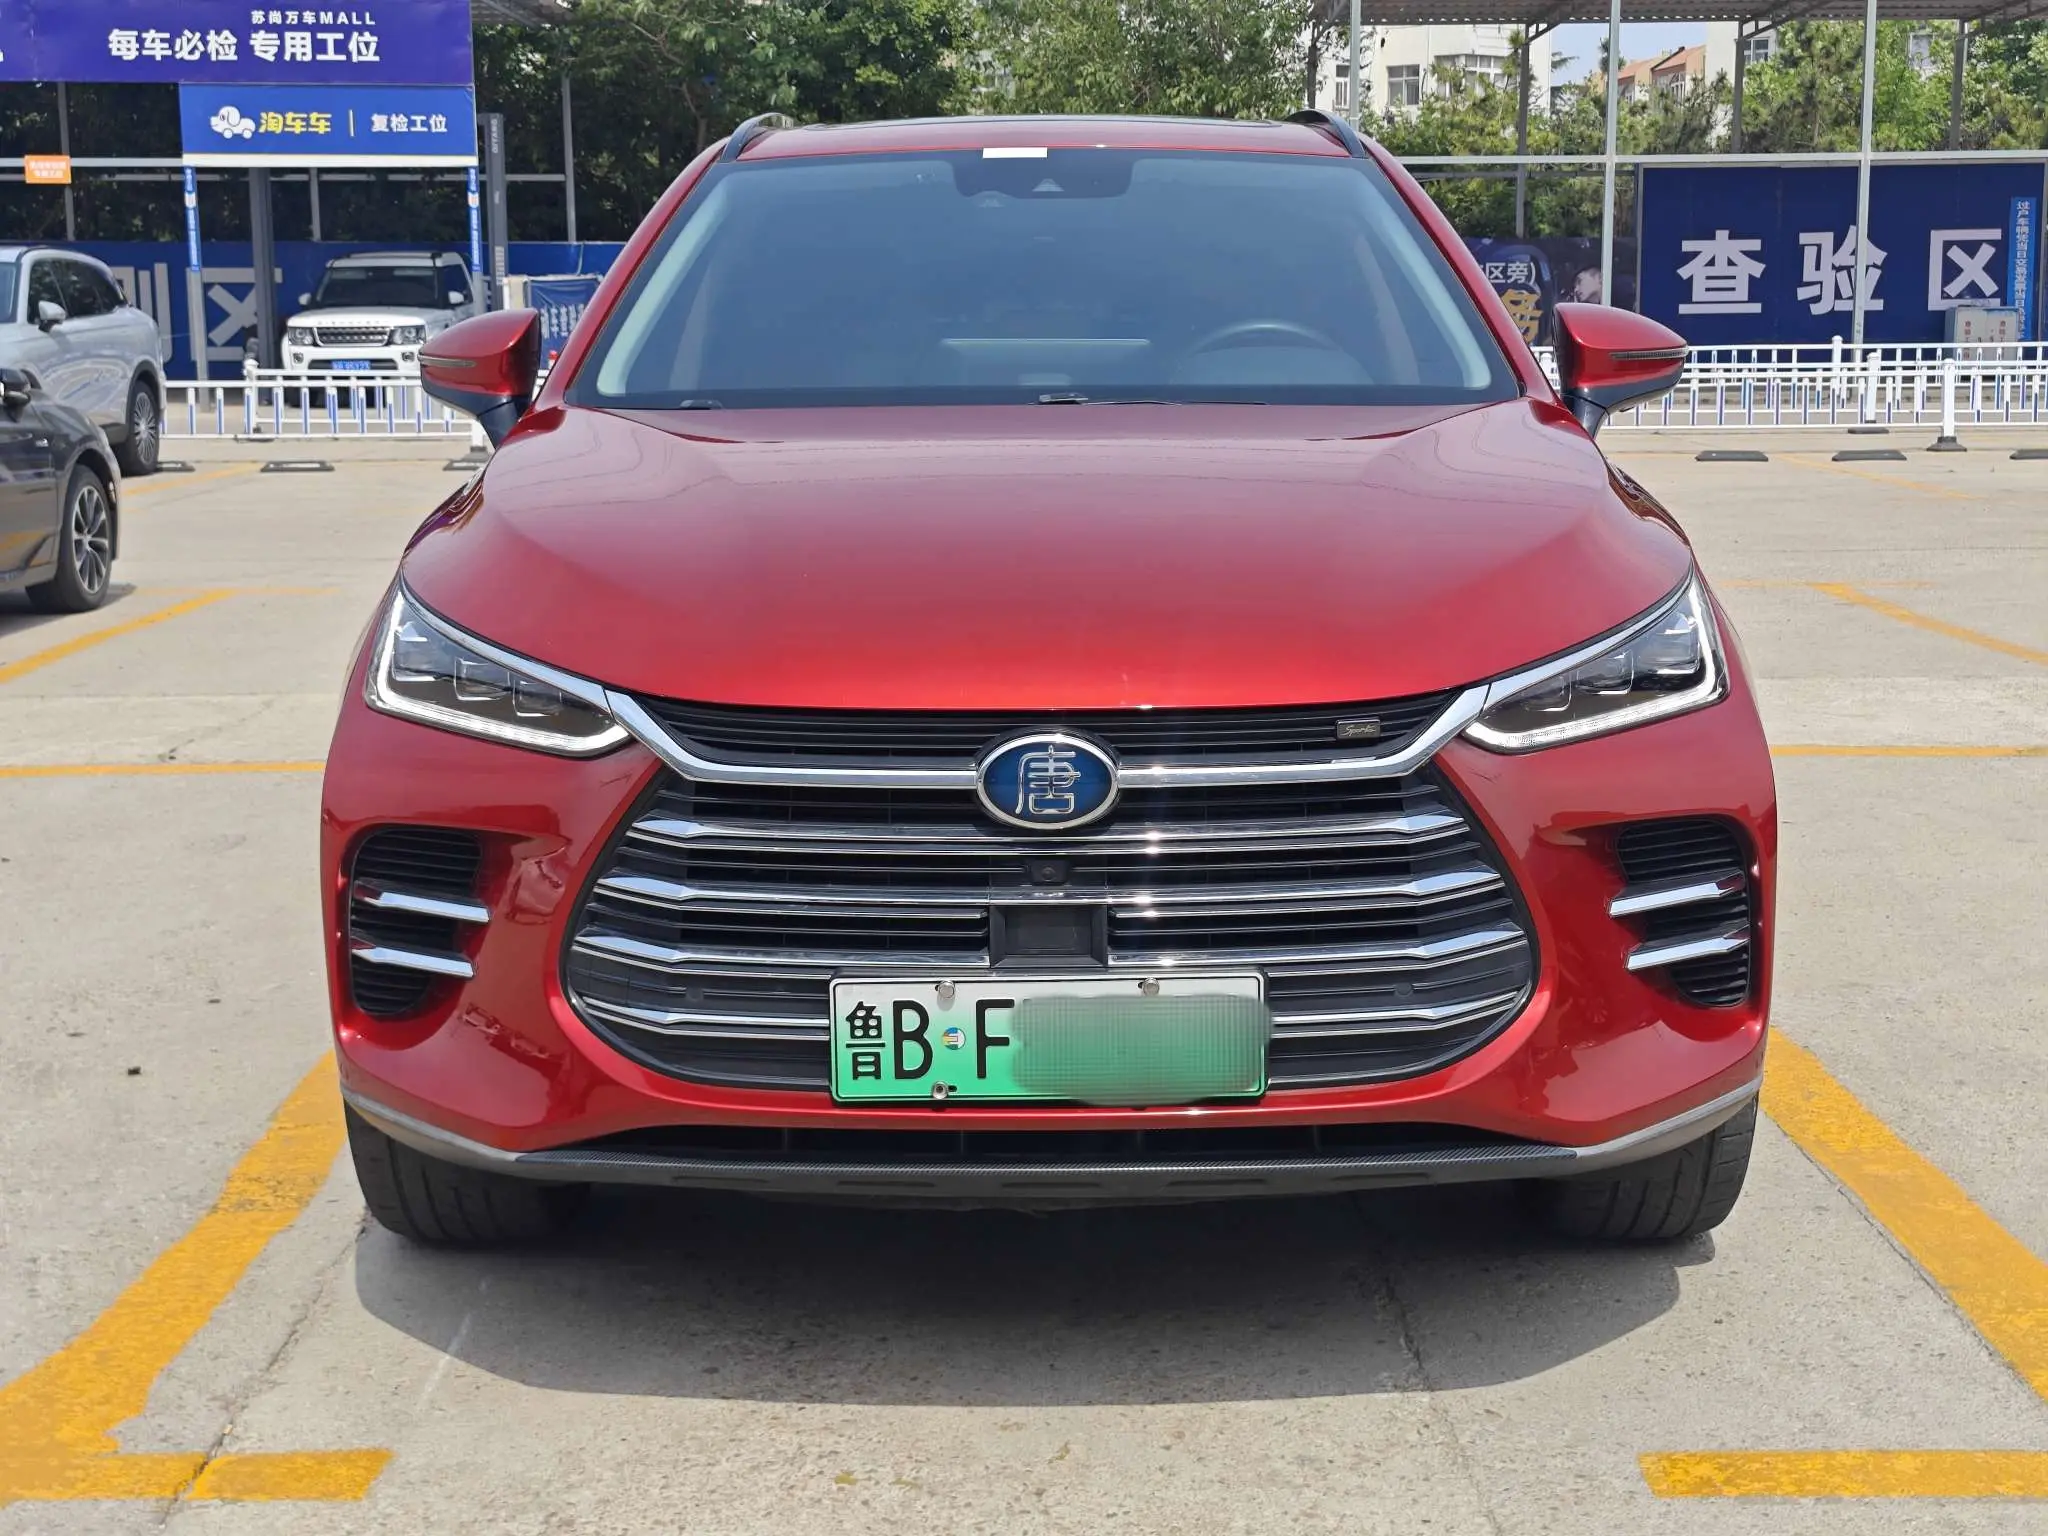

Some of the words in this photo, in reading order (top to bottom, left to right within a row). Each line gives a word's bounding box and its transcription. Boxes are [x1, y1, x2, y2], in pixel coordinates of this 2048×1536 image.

[251, 10, 376, 25] 苏尚万车MALL
[108, 28, 238, 61] 每车必检
[249, 30, 380, 62] 专用工位
[258, 111, 332, 134] 淘车车
[371, 113, 448, 133] 复检工位
[1480, 262, 1536, 285] 区旁)
[1676, 225, 2002, 316] 查验区
